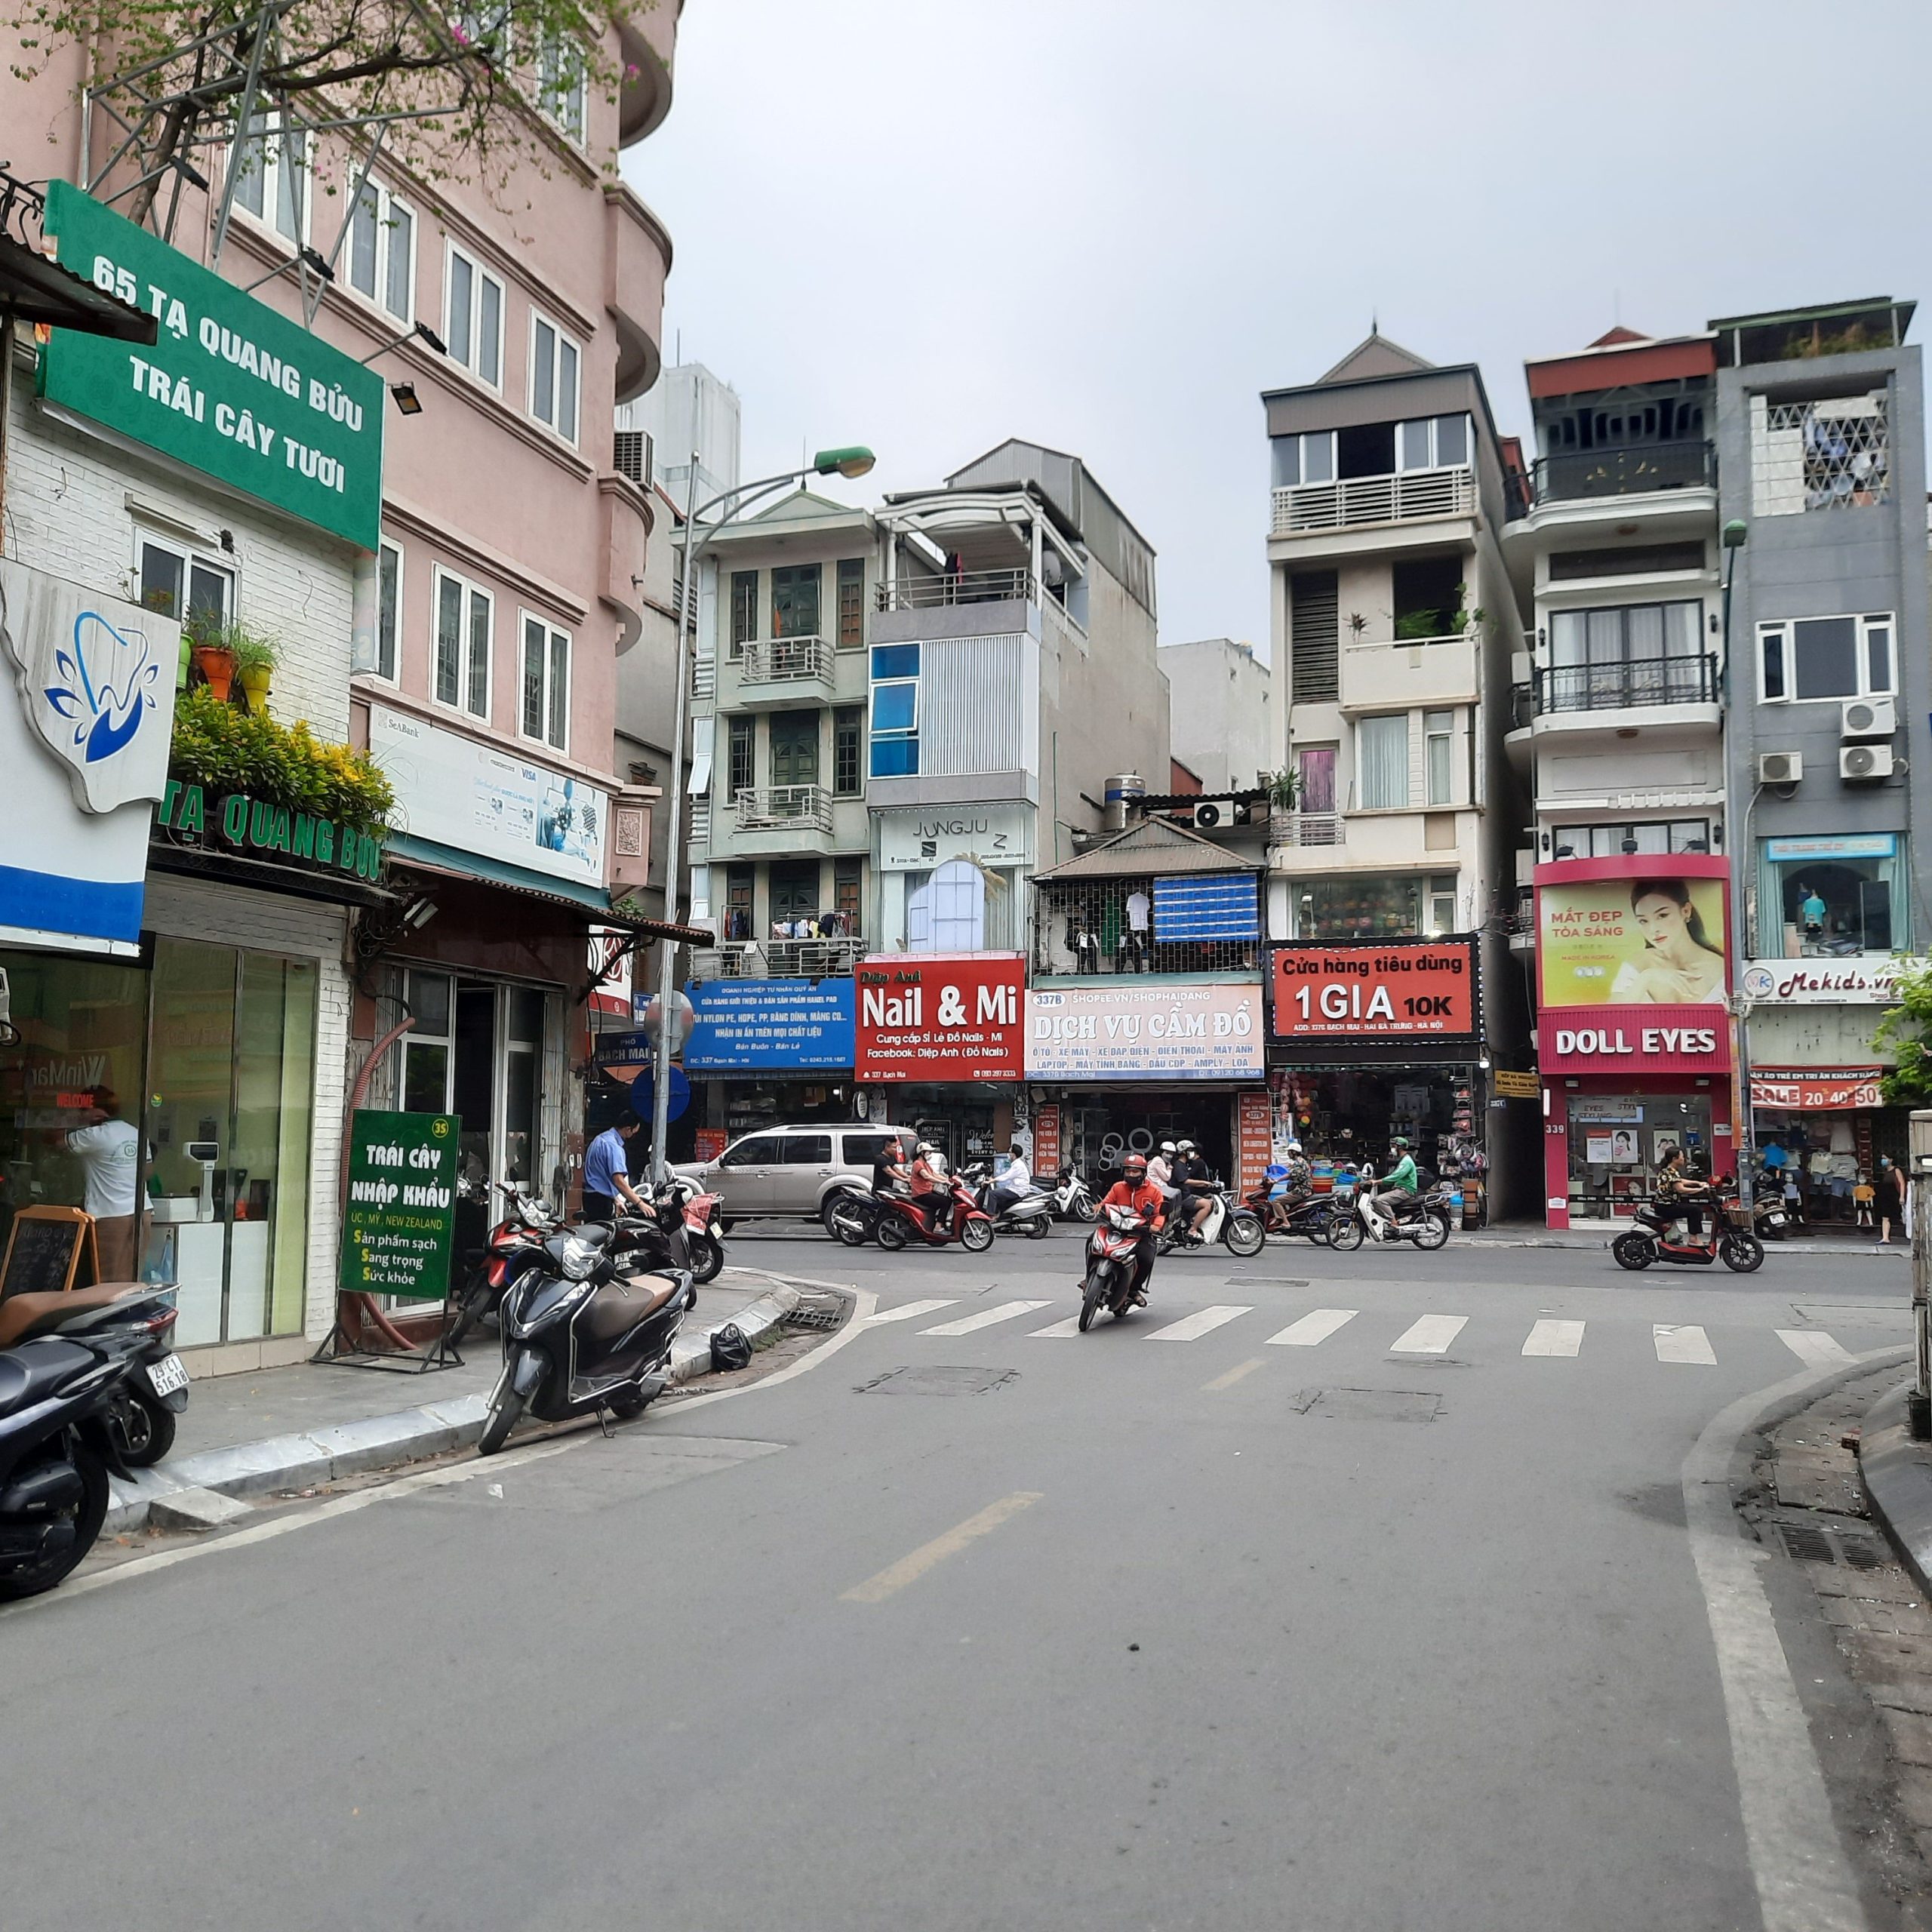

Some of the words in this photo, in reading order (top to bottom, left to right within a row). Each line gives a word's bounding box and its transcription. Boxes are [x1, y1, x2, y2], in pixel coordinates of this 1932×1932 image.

[93, 255, 137, 306] 65
[146, 284, 188, 340] TẠ
[199, 317, 300, 398] QUANG
[309, 378, 364, 432] BỬU
[130, 355, 205, 423] TRÁI
[215, 403, 275, 456] CÂY
[284, 435, 345, 494] TƯƠI
[388, 718, 420, 739] SeABank
[521, 768, 537, 782] VISA
[158, 779, 204, 842] TẠ
[223, 794, 334, 863] QUANG
[1551, 906, 1583, 923] MẮT
[1589, 911, 1623, 924] ĐẸP
[1583, 925, 1623, 937] SÁNG
[1283, 956, 1319, 975] Cửa
[1324, 957, 1369, 976] hàng
[1374, 956, 1411, 974] tiêu
[1416, 955, 1463, 974] dùng
[863, 987, 922, 1027] Nail
[937, 986, 968, 1026] &
[977, 985, 1017, 1025] Mi
[1036, 995, 1063, 1004] 337B
[1404, 996, 1452, 1017] 10K
[1034, 1014, 1097, 1045] DỊCH
[1103, 1014, 1142, 1044] VỤ
[1148, 1001, 1207, 1038] CẦM
[1213, 999, 1252, 1037] ĐỒ
[876, 1033, 901, 1046] Cung
[962, 1032, 984, 1042] Nails
[1556, 1029, 1633, 1054] DOLL
[1641, 1028, 1715, 1054] EYES
[629, 1048, 649, 1060] MAI
[940, 1047, 958, 1057] Anh
[1098, 1048, 1108, 1056] XE
[1037, 1060, 1067, 1069] LAPTOP
[1194, 1058, 1223, 1068] AMPLY
[1232, 1058, 1248, 1067] LOA
[57, 1093, 94, 1108] WELCOME
[1751, 1087, 1799, 1103] SALE
[434, 1122, 448, 1134] 3S
[1546, 1124, 1564, 1134] 339
[366, 1140, 405, 1167] TRÁI
[408, 1142, 441, 1170] CÂY
[351, 1177, 398, 1211] NHẬP
[403, 1176, 451, 1209] KHẨU
[368, 1213, 381, 1226] MỸ
[386, 1215, 405, 1228] NEW
[405, 1217, 443, 1230] ZEALAND
[353, 1229, 375, 1244] Sản
[377, 1232, 409, 1248] phẩm
[412, 1238, 437, 1252] sạch
[361, 1247, 389, 1268] Sang
[392, 1254, 423, 1270] trọng
[362, 1266, 385, 1282] Sức
[387, 1271, 416, 1285] khỏe
[156, 1371, 188, 1394] 516.18
